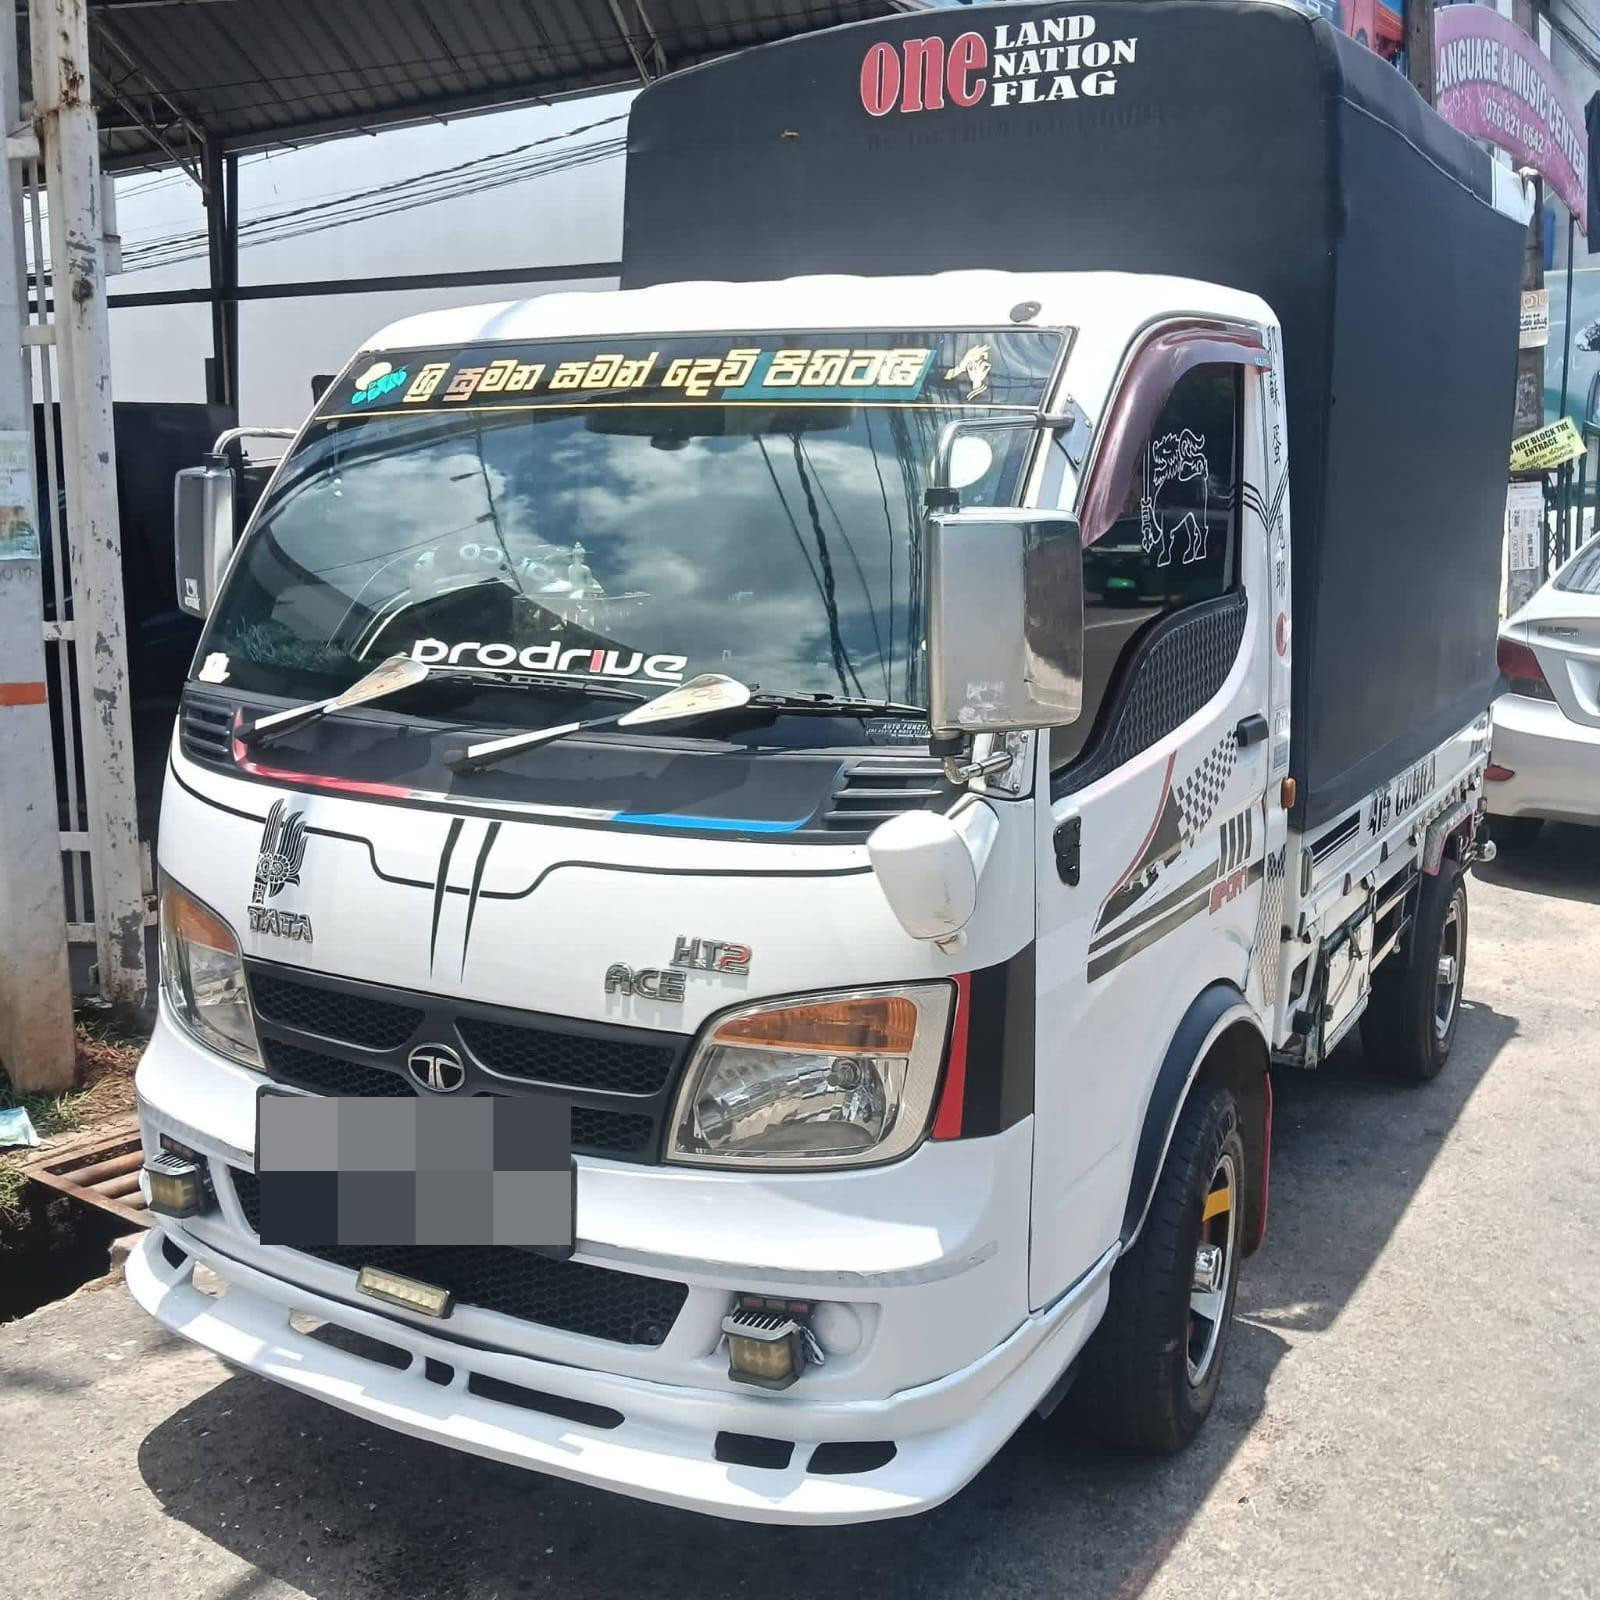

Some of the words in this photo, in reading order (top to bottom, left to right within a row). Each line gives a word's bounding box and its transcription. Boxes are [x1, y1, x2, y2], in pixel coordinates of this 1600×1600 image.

[994, 14, 1096, 50] LAND
[860, 31, 988, 117] one
[992, 38, 1138, 79] NATION
[990, 70, 1118, 107] FLAG
[1485, 98, 1502, 127] 076
[1505, 111, 1520, 138] 821
[1501, 45, 1511, 88] &
[1512, 51, 1547, 119] MUSIC
[1548, 95, 1586, 187] CENTER
[442, 359, 545, 401] සුමන
[548, 352, 659, 388] සමන්
[1514, 439, 1530, 453] NOT
[1530, 428, 1556, 445] BLOCK
[1556, 421, 1569, 434] THE
[1524, 437, 1559, 457] ENTRACE
[411, 638, 688, 680] prodrive
[247, 905, 313, 944] TATA
[669, 934, 753, 975] HT2
[604, 961, 687, 1003] ACE
